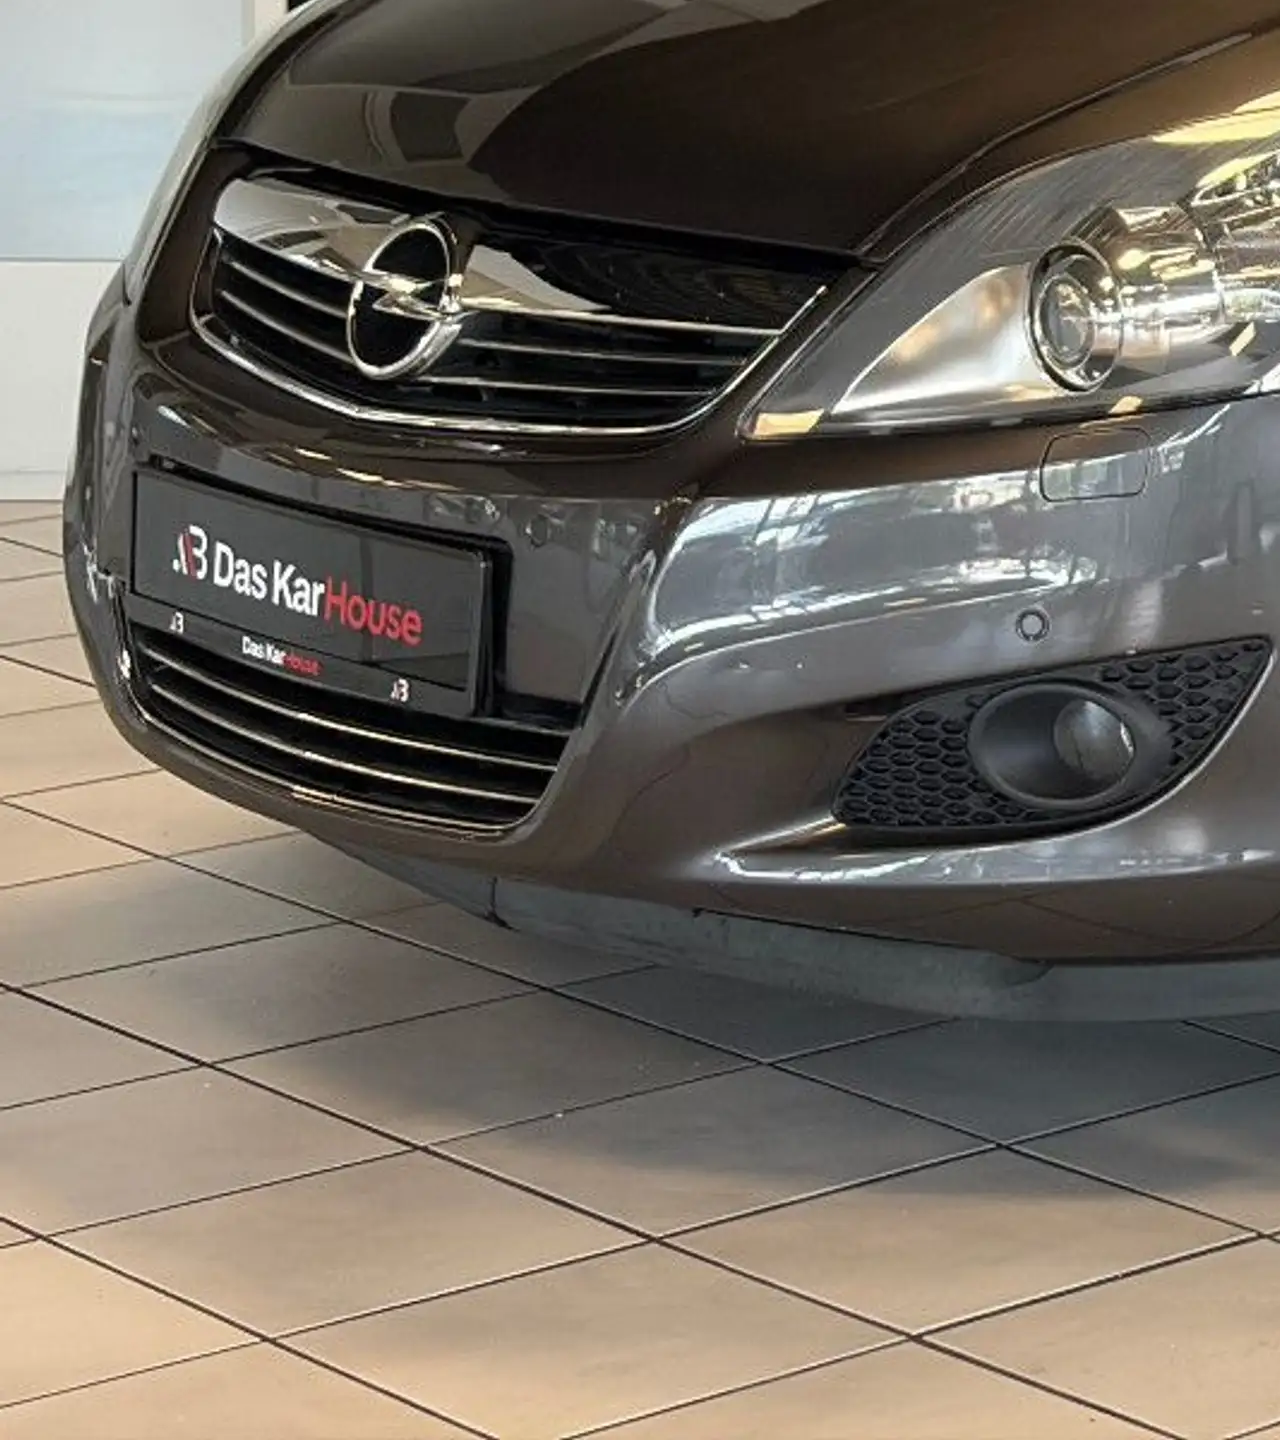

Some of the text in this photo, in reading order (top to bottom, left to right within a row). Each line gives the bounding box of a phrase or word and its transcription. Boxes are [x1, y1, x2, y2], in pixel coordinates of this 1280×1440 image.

[213, 540, 268, 600] Das
[272, 559, 423, 646] KarHouse
[242, 635, 266, 660] Das
